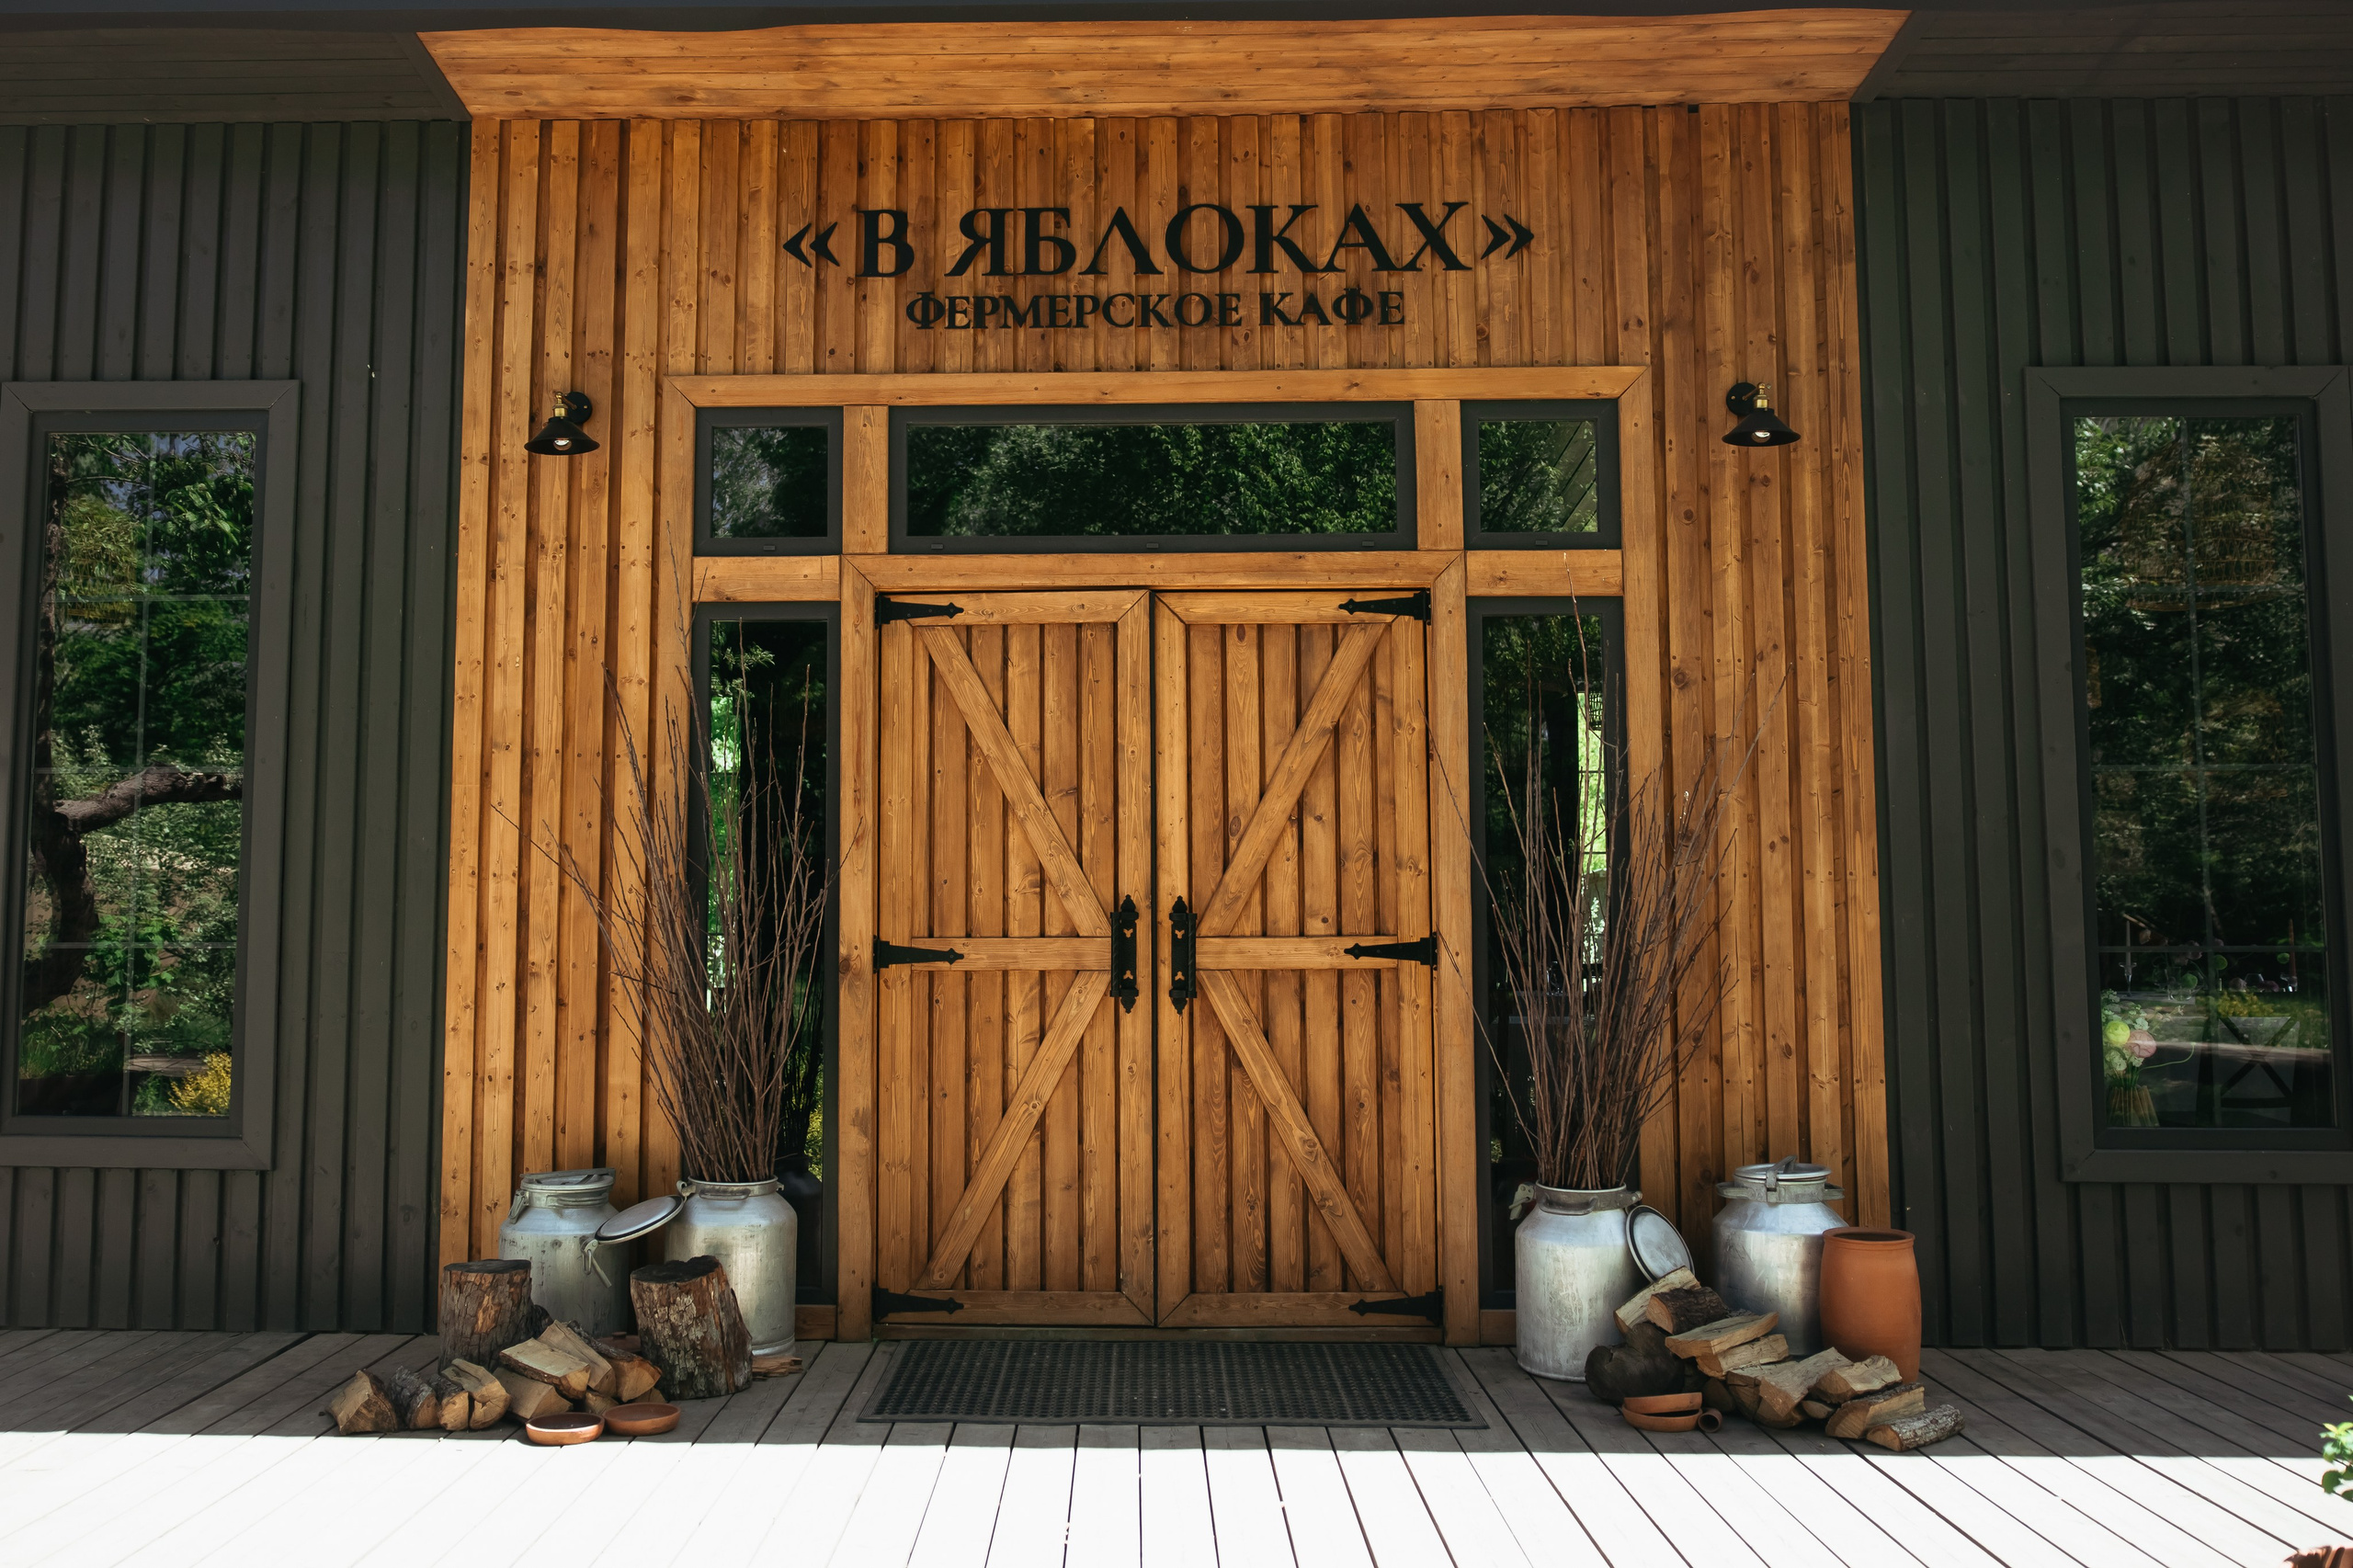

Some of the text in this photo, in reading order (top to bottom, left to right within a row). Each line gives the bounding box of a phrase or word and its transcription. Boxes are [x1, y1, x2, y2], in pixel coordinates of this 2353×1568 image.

[782, 201, 1535, 278] «В ЯБЛОКАХ»
[906, 287, 1404, 330] ФЕРМЕРСКОЕ КАФЕ
